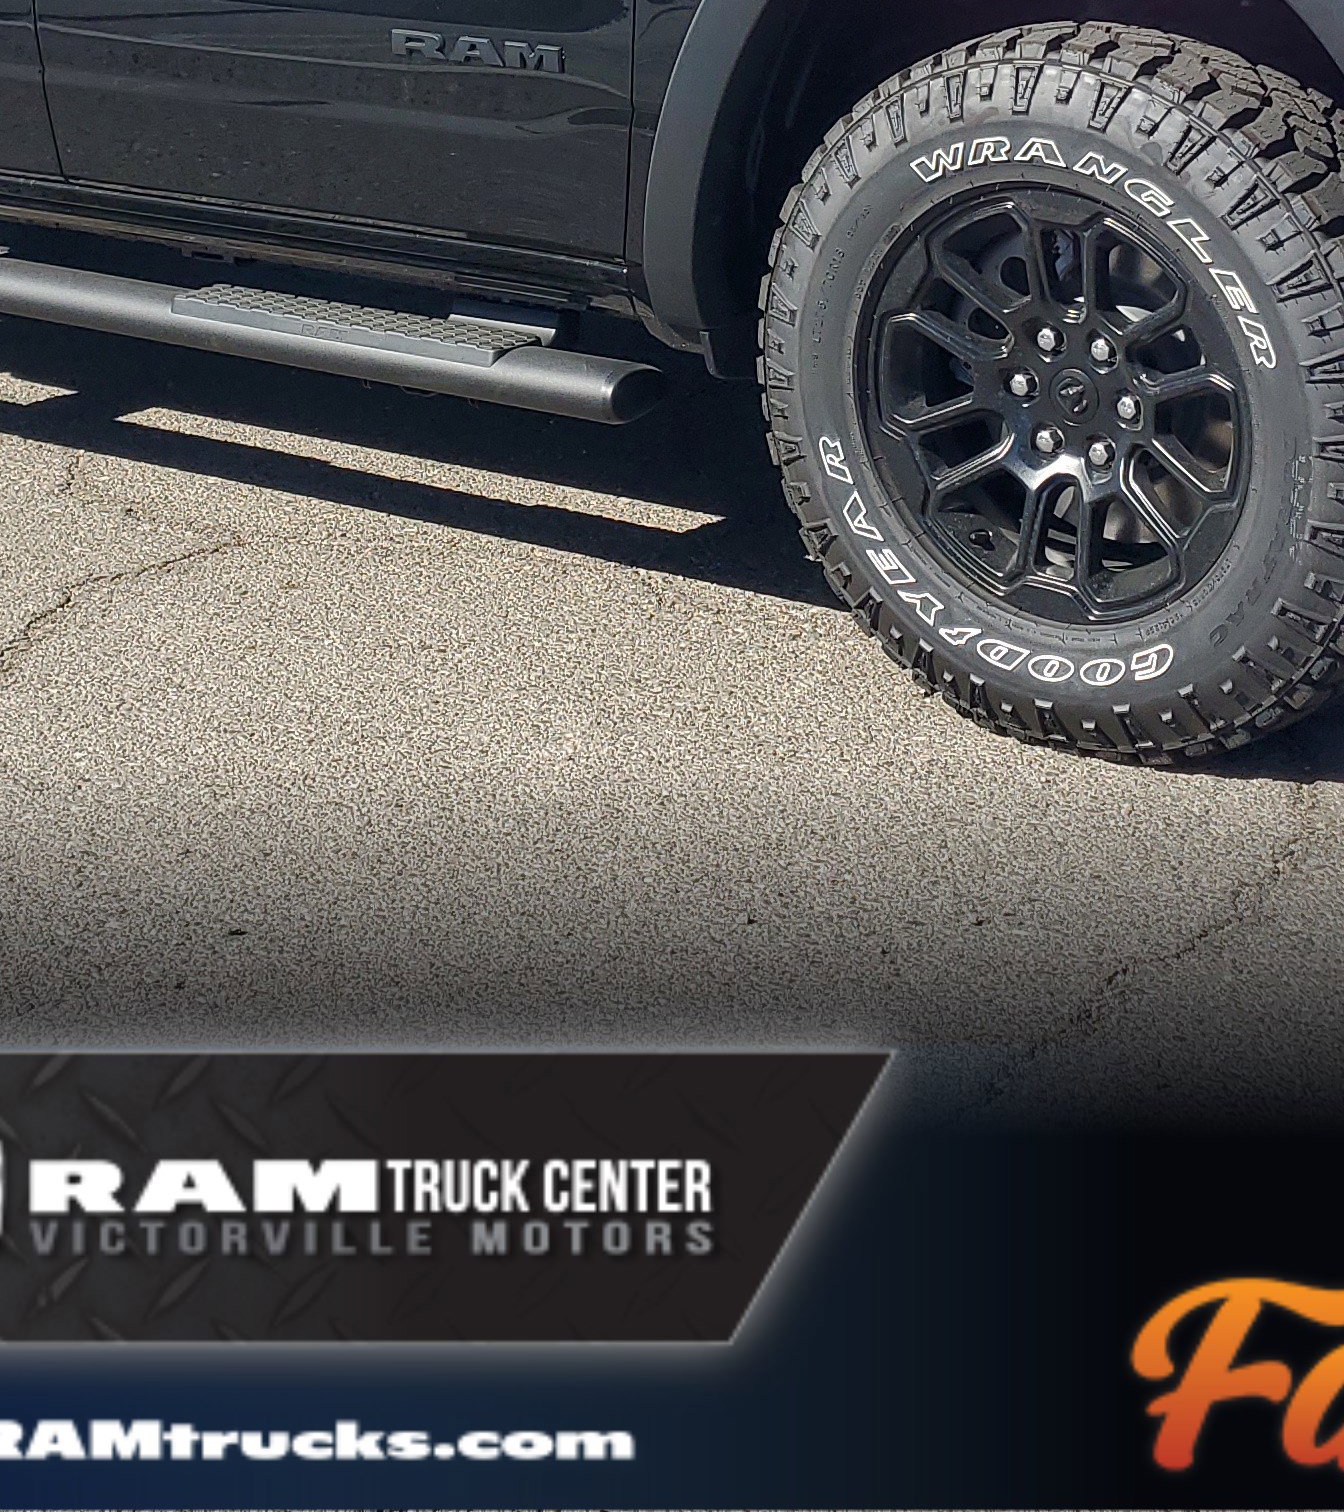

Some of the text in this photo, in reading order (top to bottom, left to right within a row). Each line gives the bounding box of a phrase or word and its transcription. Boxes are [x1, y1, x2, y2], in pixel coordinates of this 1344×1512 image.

[391, 28, 565, 74] RAM
[909, 135, 1276, 370] WRANGLER
[818, 435, 1175, 687] GOODYEAR
